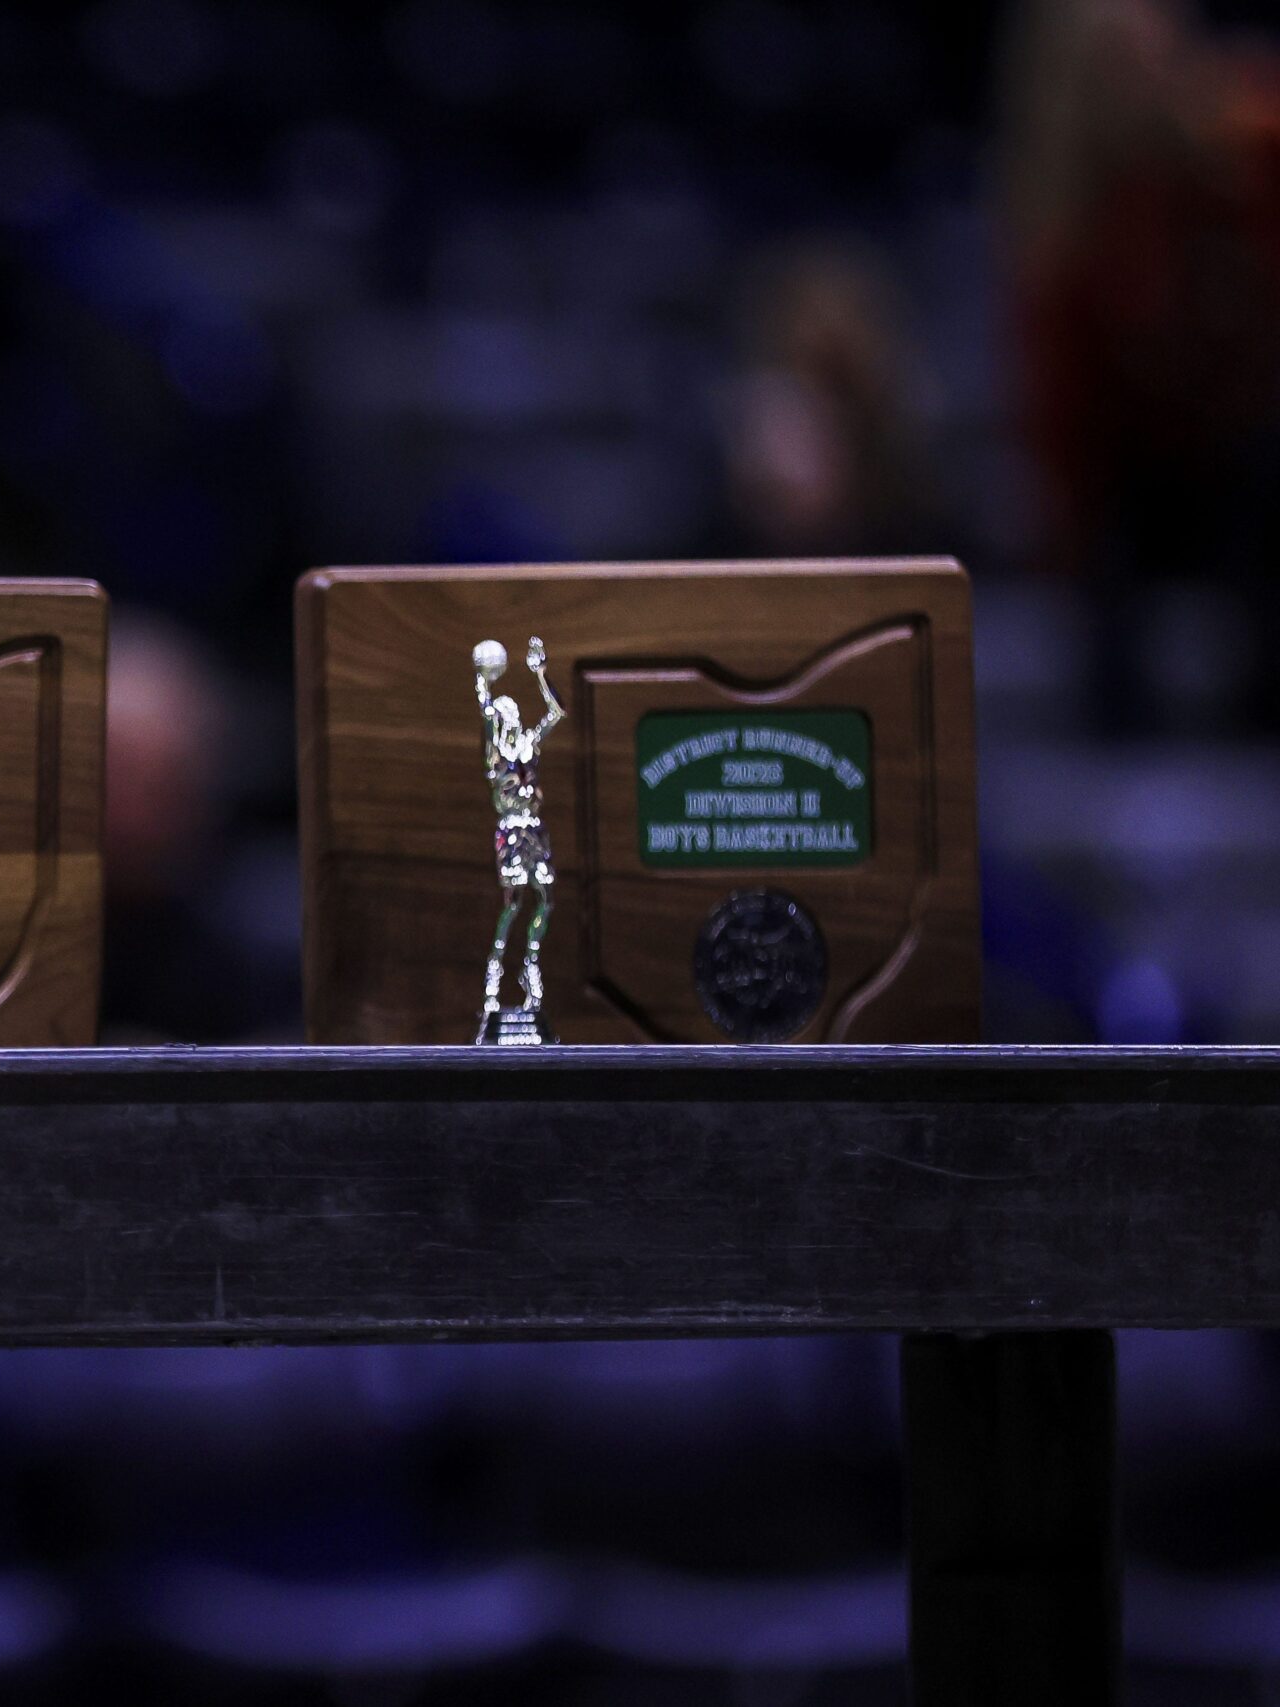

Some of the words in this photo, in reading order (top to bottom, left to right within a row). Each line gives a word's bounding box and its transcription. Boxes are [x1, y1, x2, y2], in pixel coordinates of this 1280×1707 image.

[640, 727, 740, 789] DISTRICT
[684, 790, 798, 818] DIVISION
[647, 822, 711, 852] BOYS
[713, 822, 859, 852] BASKETBALL
